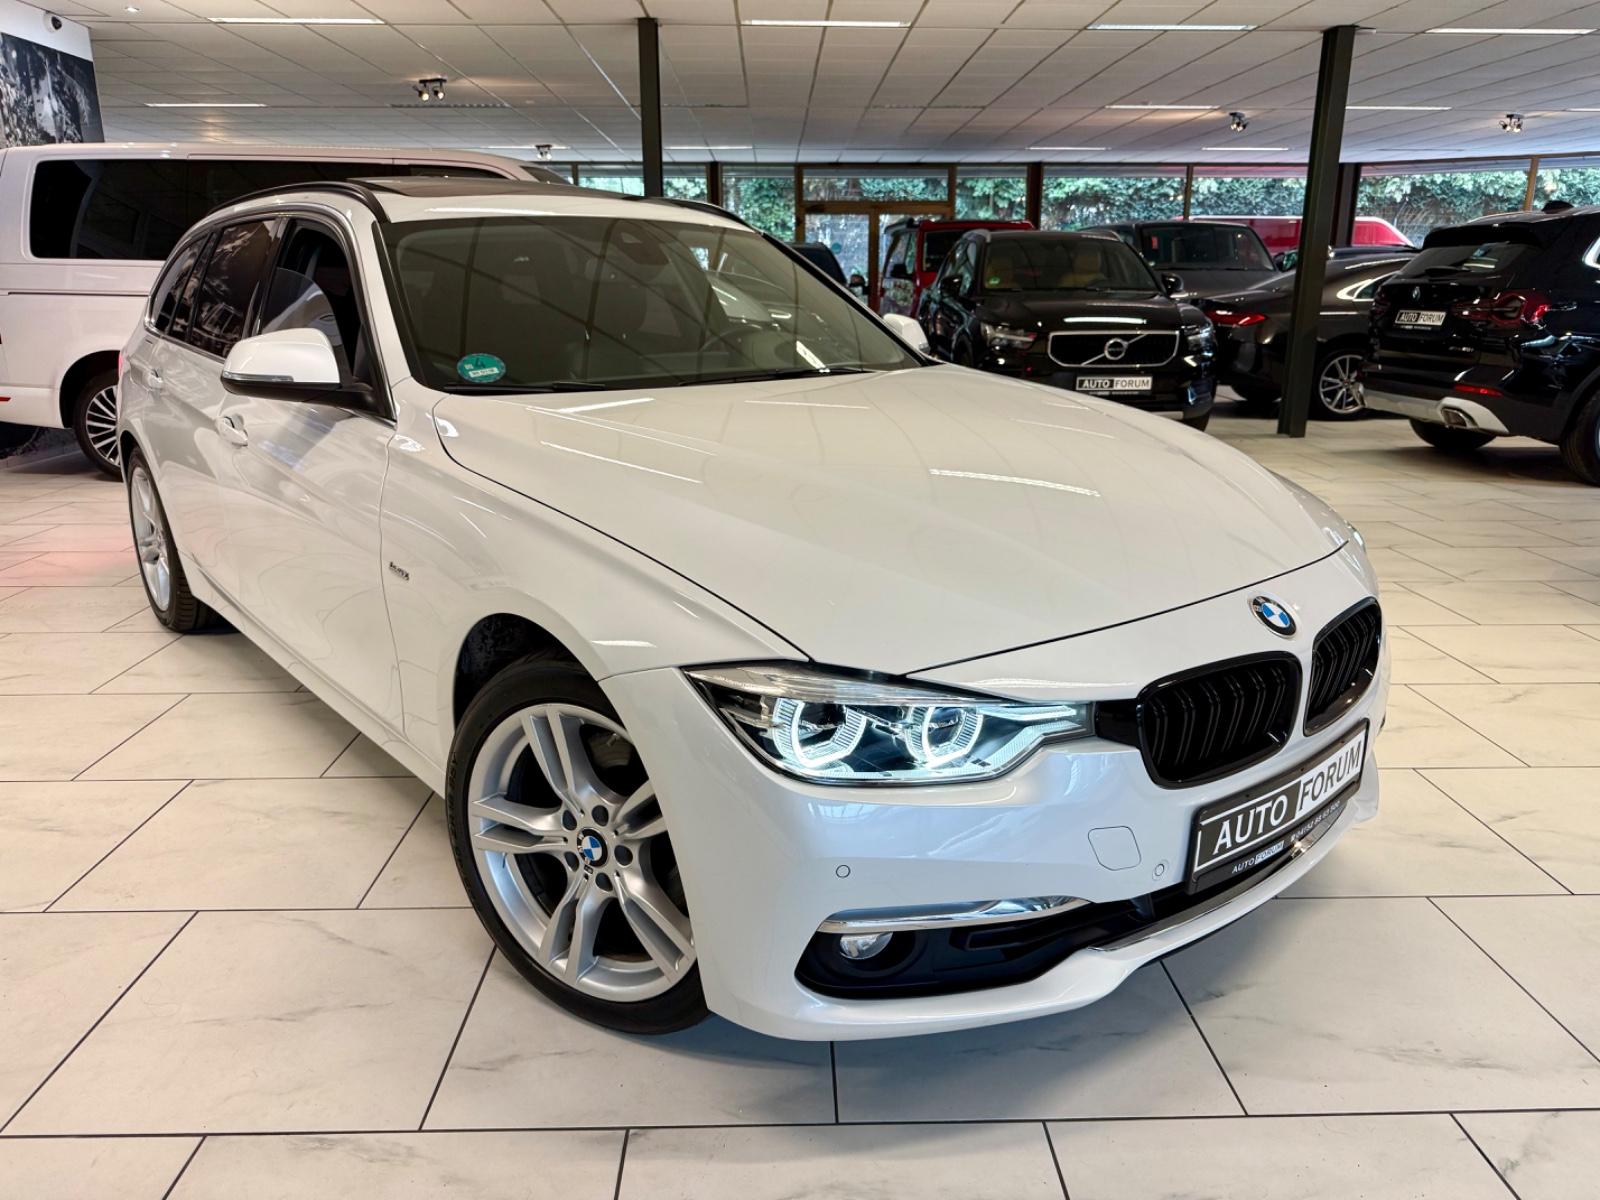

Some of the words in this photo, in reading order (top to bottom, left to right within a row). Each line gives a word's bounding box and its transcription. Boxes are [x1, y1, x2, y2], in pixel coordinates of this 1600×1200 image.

[1399, 312, 1418, 322] AUTO
[1082, 379, 1110, 388] AUTO
[1115, 379, 1150, 388] FORUM
[1213, 794, 1288, 855] AUTO
[1299, 740, 1362, 811] FORUM
